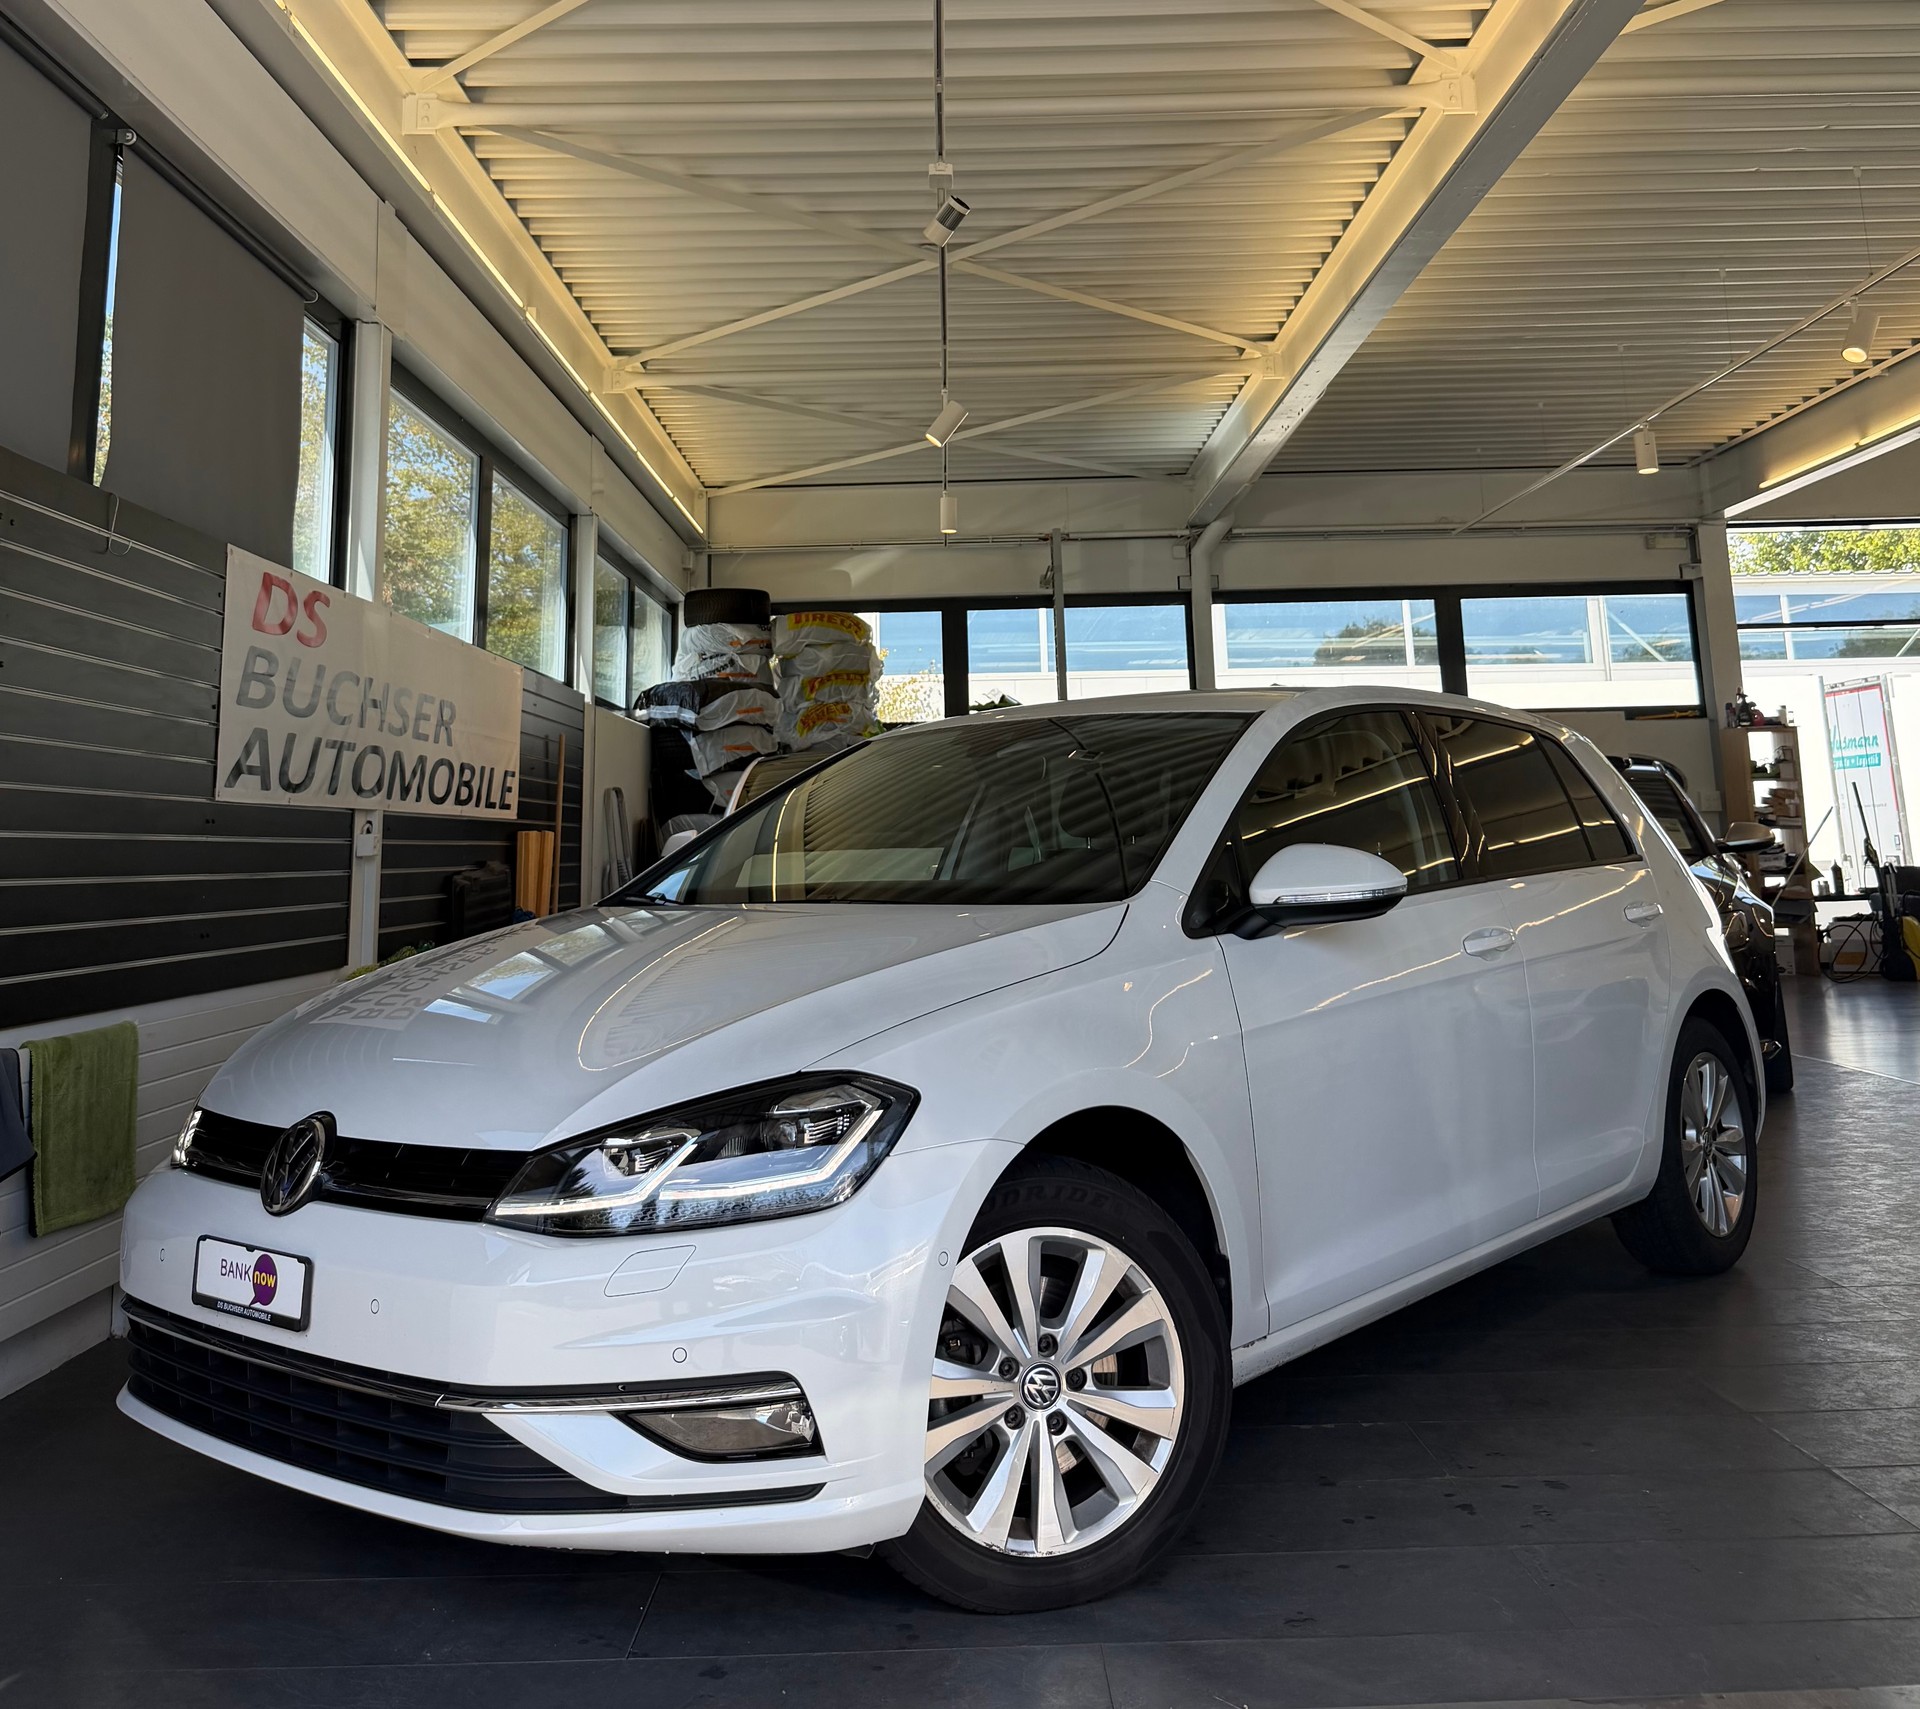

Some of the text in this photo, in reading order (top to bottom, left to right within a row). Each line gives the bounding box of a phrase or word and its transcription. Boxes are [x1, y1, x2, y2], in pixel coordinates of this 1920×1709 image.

[252, 571, 331, 648] DS
[235, 645, 457, 747] BUCHSER
[224, 727, 516, 811] AUTOMOBILE
[220, 1258, 277, 1288] BANK now
[223, 1302, 244, 1315] BUCHSER
[243, 1308, 272, 1321] AUTOMOBILE
